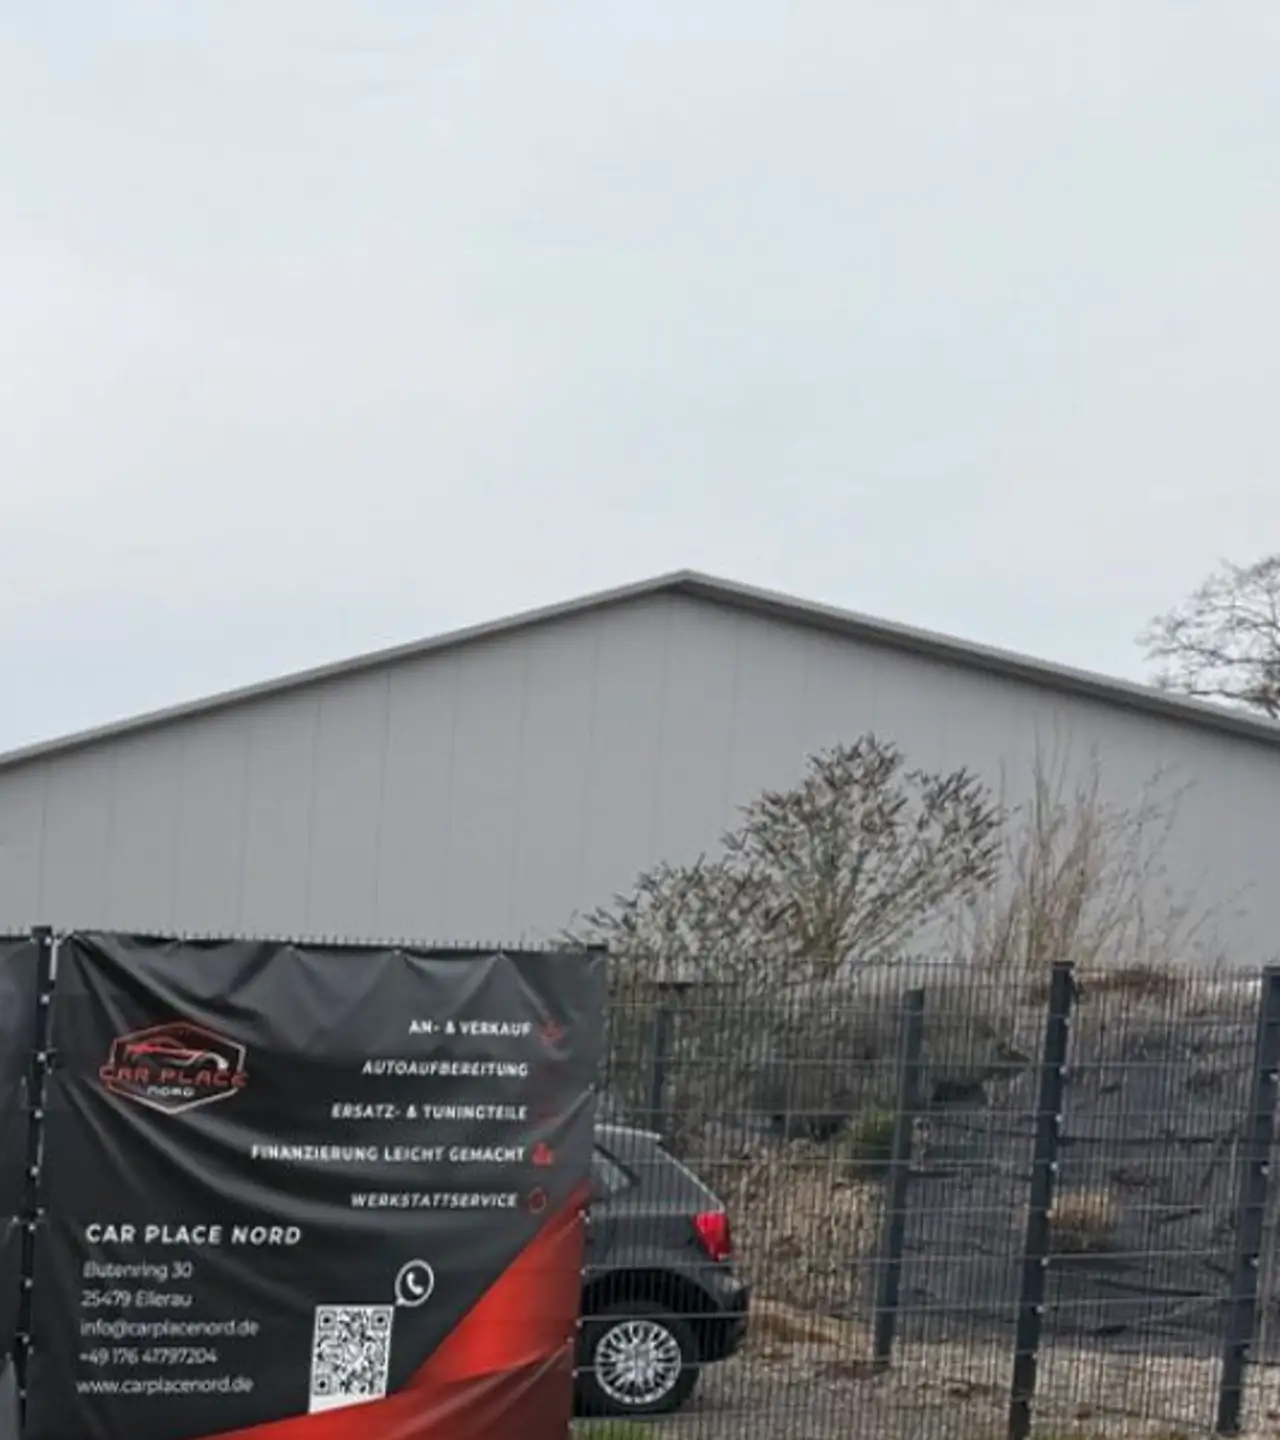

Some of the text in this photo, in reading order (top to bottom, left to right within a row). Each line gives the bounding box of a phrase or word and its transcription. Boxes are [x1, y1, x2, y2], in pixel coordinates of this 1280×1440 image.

[408, 1020, 532, 1036] AN- & VERKAUF
[99, 1066, 248, 1087] CAR PLACE
[362, 1059, 529, 1078] AUTOAUFBEREITUNG
[331, 1103, 528, 1121] ERSATZ- & TUNINGTEILE
[251, 1145, 525, 1163] FINANZIERUNG LEICHT GEMACHT
[351, 1193, 518, 1209] WERKSTATTSERVICE
[85, 1224, 301, 1245] CAR PLACE NORD
[171, 1261, 194, 1278] 30
